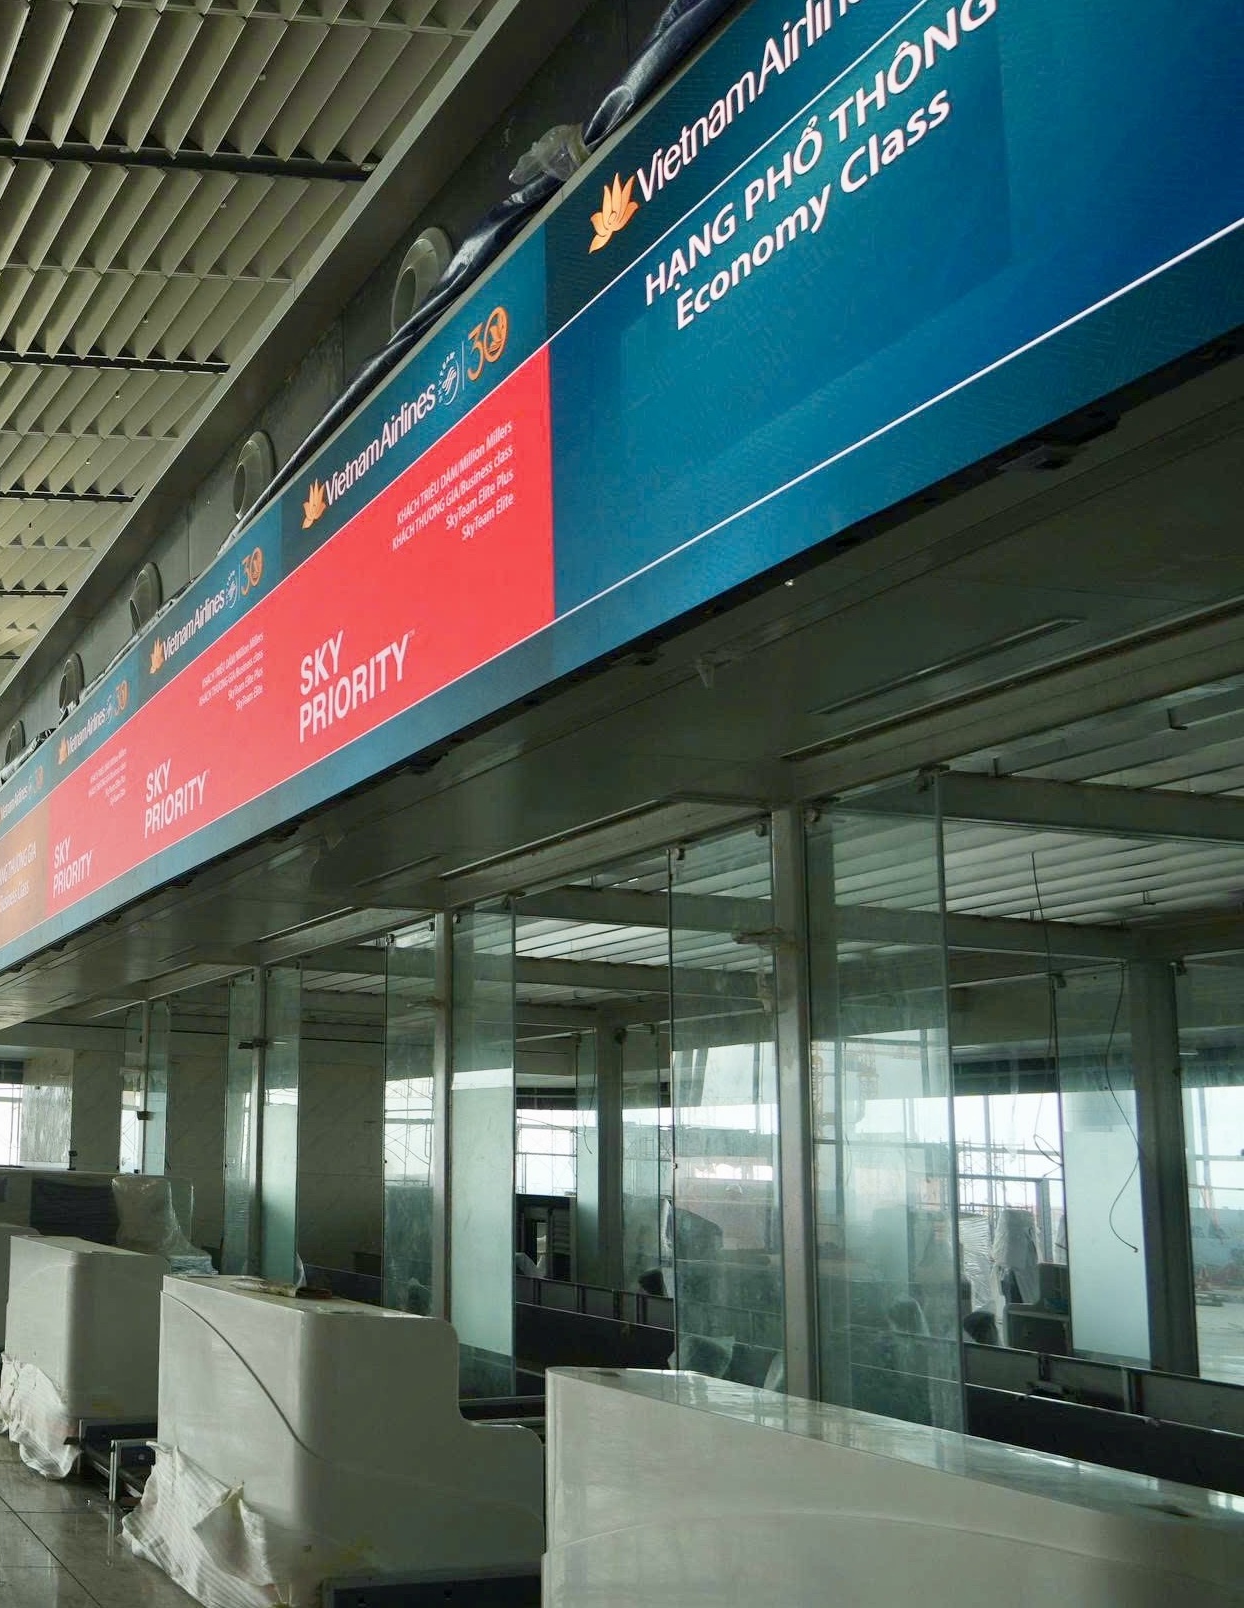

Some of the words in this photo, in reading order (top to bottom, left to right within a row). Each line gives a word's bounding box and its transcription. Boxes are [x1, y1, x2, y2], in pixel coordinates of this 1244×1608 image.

[645, 203, 737, 307] HẠNG
[744, 115, 823, 222] PHỔ
[828, 0, 997, 142] THÔNG
[677, 185, 830, 330] Economy
[840, 90, 950, 193] Class
[496, 469, 514, 491] Plus
[299, 633, 408, 743] PRIORITY
[300, 630, 344, 696] SKY
[144, 770, 207, 839] PRIORITY
[146, 758, 171, 803] SKY
[52, 849, 93, 898] PRIORITY
[54, 835, 71, 869] SKY
